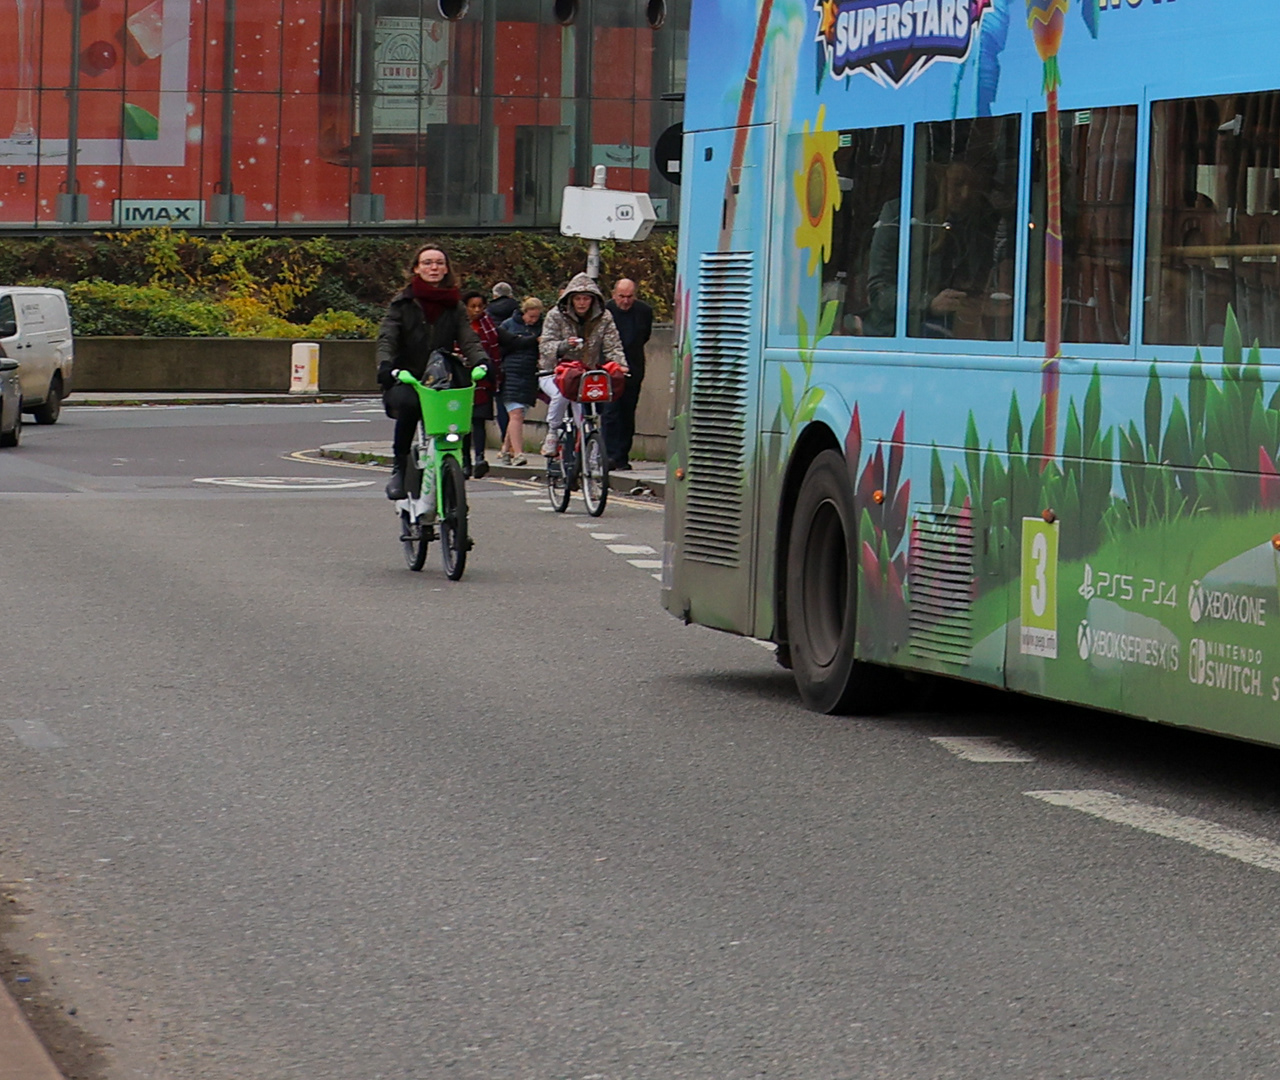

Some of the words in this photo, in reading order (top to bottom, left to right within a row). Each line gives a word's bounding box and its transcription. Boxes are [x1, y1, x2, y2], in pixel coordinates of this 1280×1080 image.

[1030, 531, 1048, 618] 3
[1097, 572, 1134, 601] PS5
[1142, 578, 1178, 609] PS4
[1207, 641, 1263, 665] NINTENDO
[1205, 660, 1263, 697] SWITCH
